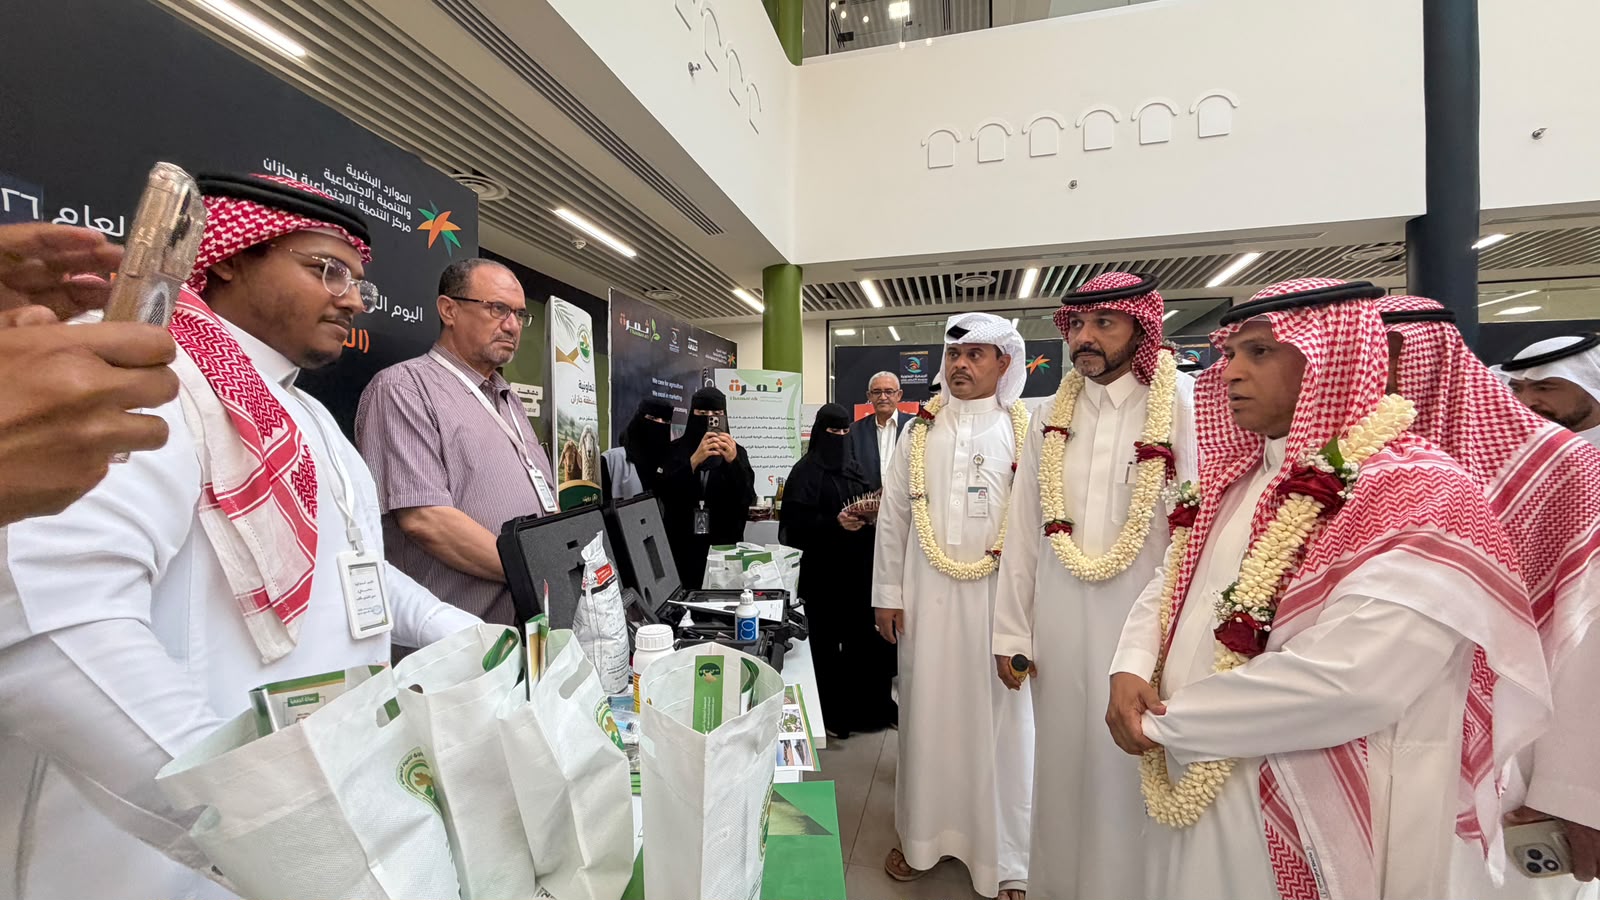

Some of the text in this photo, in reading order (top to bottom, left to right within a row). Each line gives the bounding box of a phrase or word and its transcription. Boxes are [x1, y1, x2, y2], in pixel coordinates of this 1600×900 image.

[323, 168, 412, 220] والتنمية الاجتماعية
[346, 163, 412, 205] الموارد البشرية
[51, 204, 125, 238] لعام
[358, 200, 390, 223] التنمية
[391, 216, 412, 233] مركز
[391, 305, 423, 323] اليوم
[729, 378, 783, 396] ثمرة
